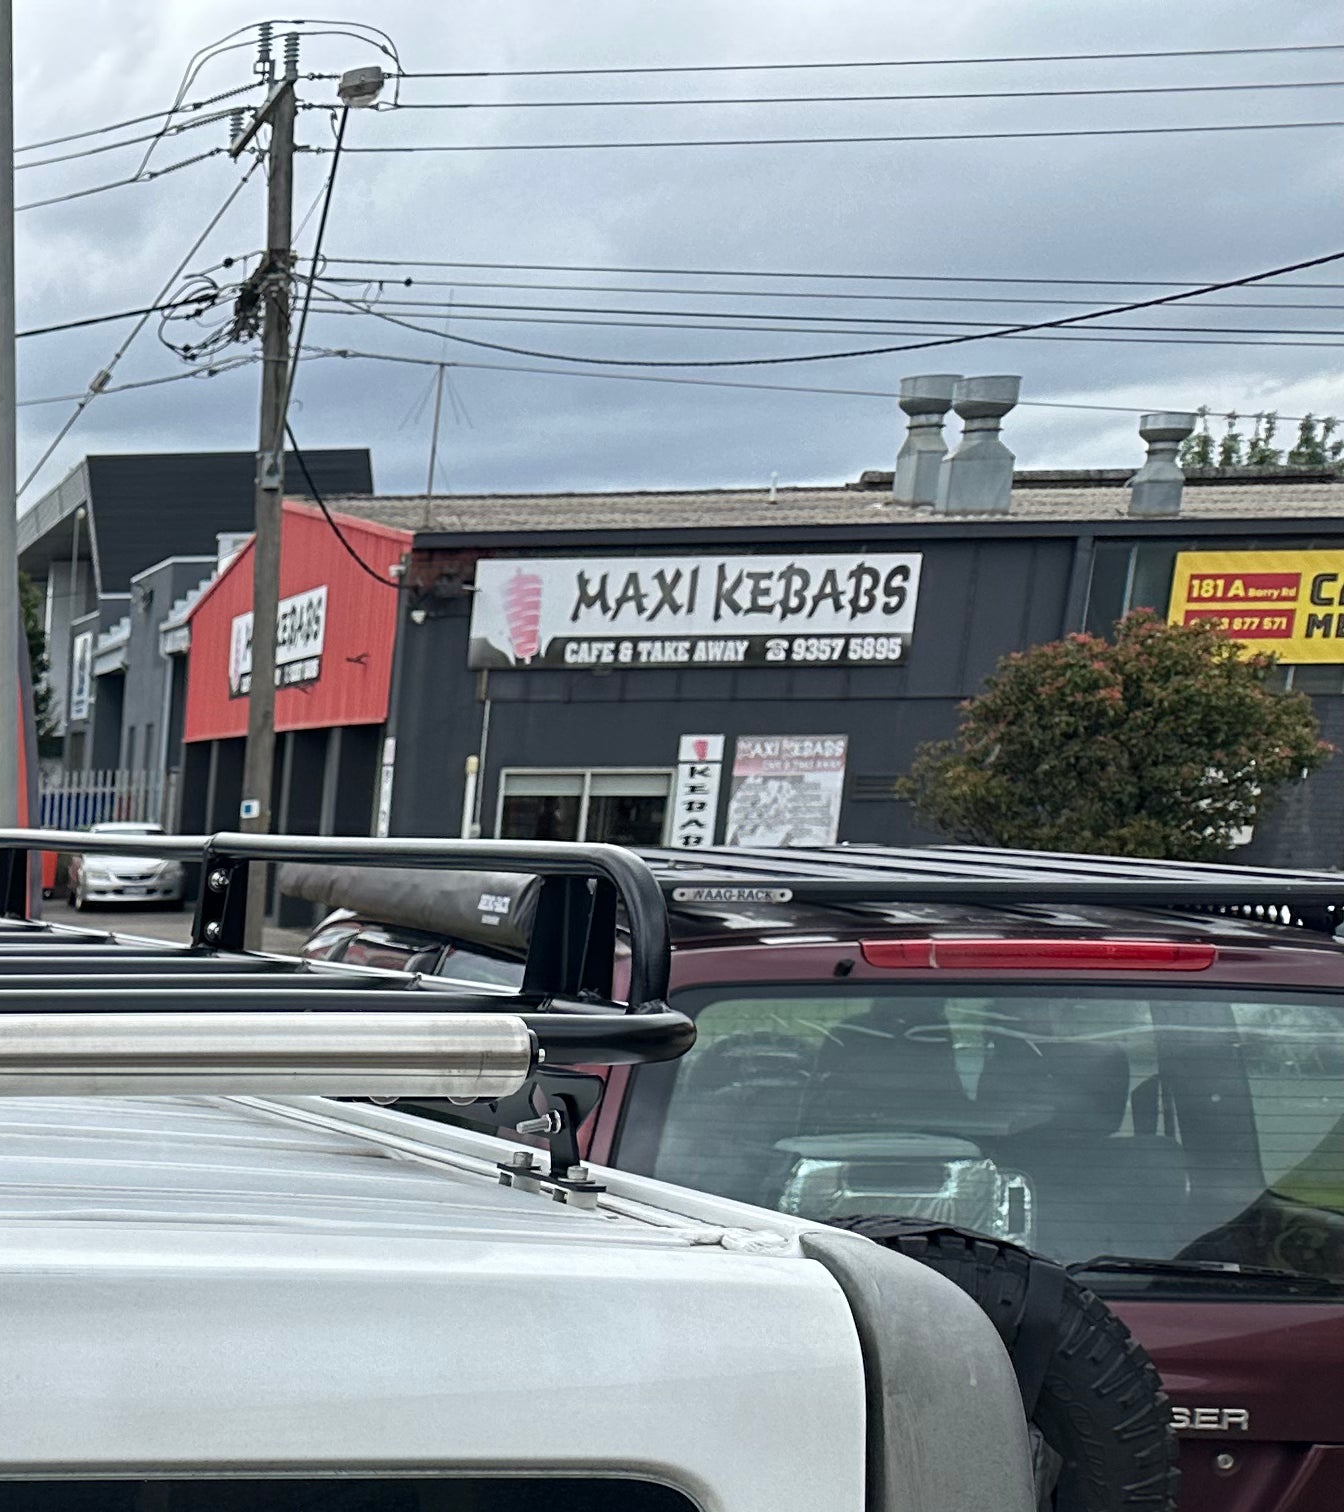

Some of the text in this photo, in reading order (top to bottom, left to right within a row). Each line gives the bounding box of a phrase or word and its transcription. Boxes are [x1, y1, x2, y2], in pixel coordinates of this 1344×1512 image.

[571, 561, 910, 623] MAXI KEBABS
[1191, 578, 1225, 598] 181
[1227, 579, 1246, 597] A
[1263, 616, 1287, 630] 571
[565, 636, 901, 664] CAFE & TAKE AWAY 9357 5895
